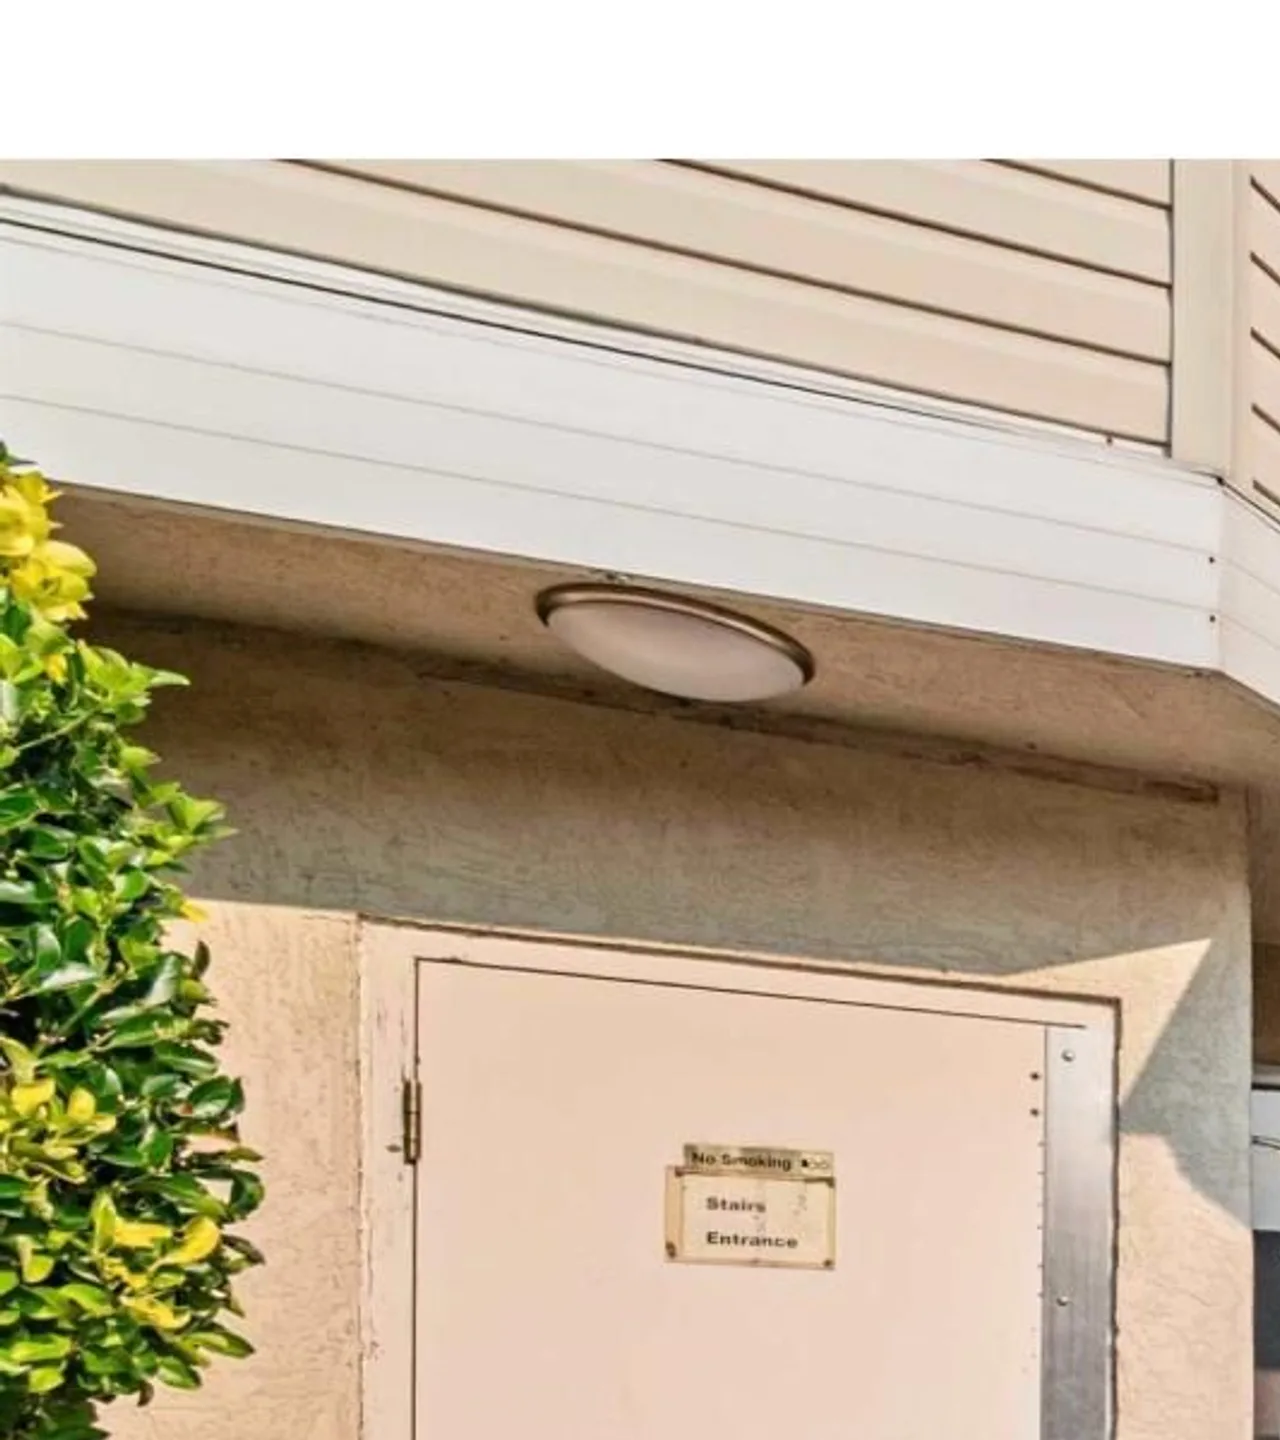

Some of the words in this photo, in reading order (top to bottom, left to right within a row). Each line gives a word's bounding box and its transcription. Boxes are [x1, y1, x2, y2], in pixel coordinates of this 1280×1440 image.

[691, 1151, 717, 1165] No
[721, 1153, 793, 1172] Smoking
[705, 1196, 767, 1214] Stairs
[705, 1230, 799, 1249] Entrance
